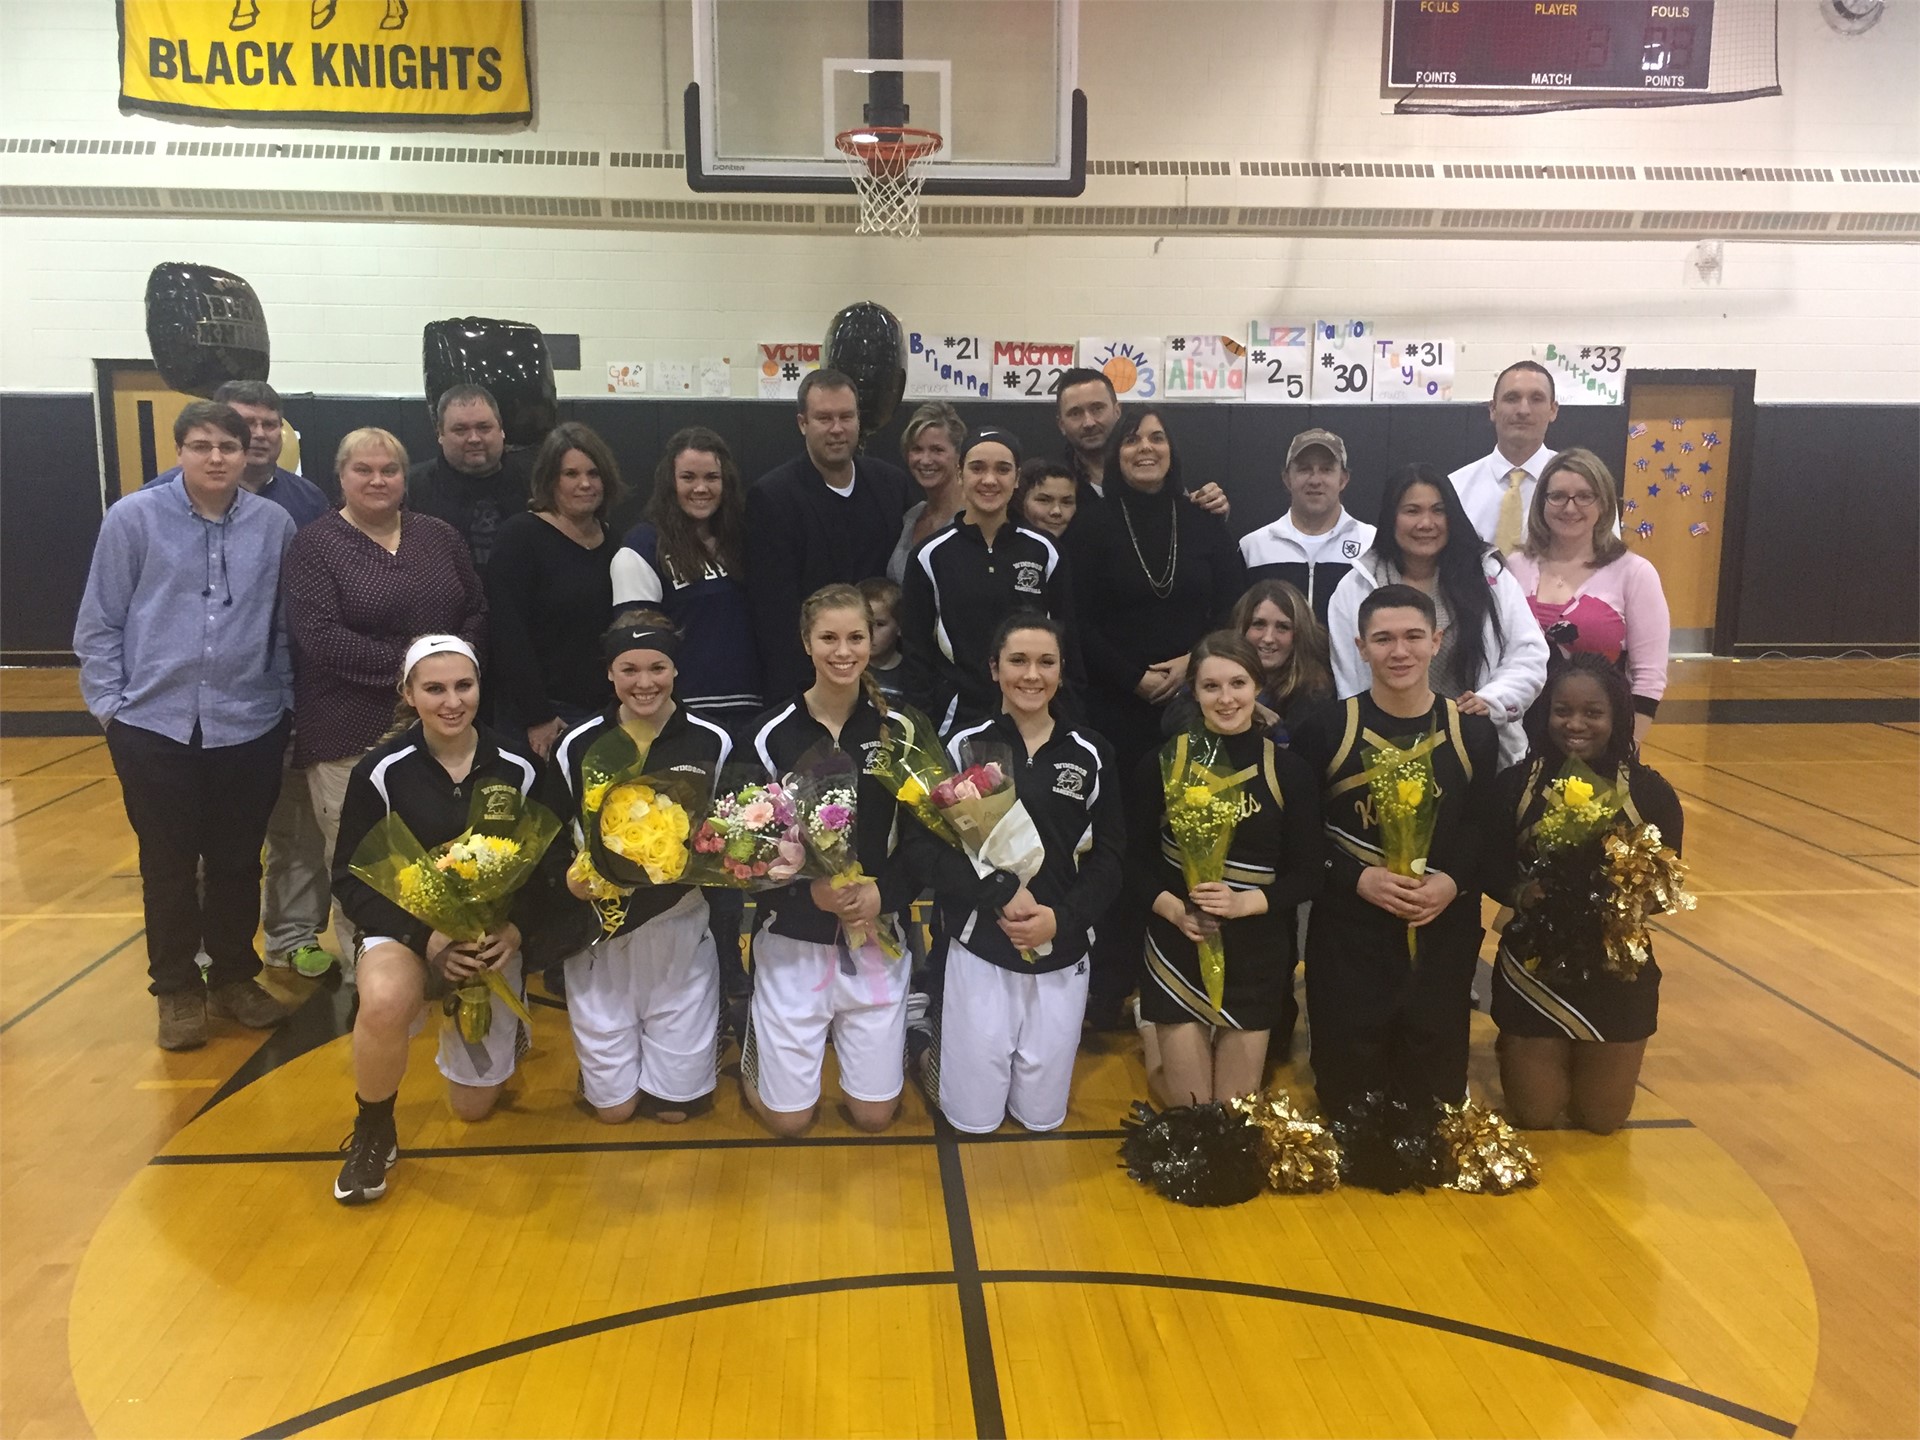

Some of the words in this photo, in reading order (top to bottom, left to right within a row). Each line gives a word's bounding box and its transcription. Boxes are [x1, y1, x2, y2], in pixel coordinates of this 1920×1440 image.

[1420, 1, 1460, 14] FOULS
[1534, 3, 1577, 16] PLAYER
[1651, 6, 1690, 19] FOULS
[148, 36, 297, 87] BLACK
[311, 41, 502, 92] KNIGHTS
[1415, 71, 1457, 84] POINTS
[1531, 72, 1572, 85] MATCH
[1645, 74, 1685, 87] POINTS
[1172, 336, 1217, 357] #24
[1317, 319, 1375, 350] Payton
[944, 337, 979, 360] #21
[1094, 342, 1149, 367] LYNN
[1405, 342, 1442, 367] #31
[1580, 346, 1622, 373] #33
[909, 333, 988, 397] Brianna
[1167, 358, 1243, 391] Alivia
[1251, 350, 1304, 398] #25
[1321, 352, 1368, 393] #30
[1546, 344, 1618, 405] Brittany
[1003, 368, 1060, 396] #22
[670, 764, 706, 776] WINDSOR
[1053, 763, 1088, 777] WINDSOR
